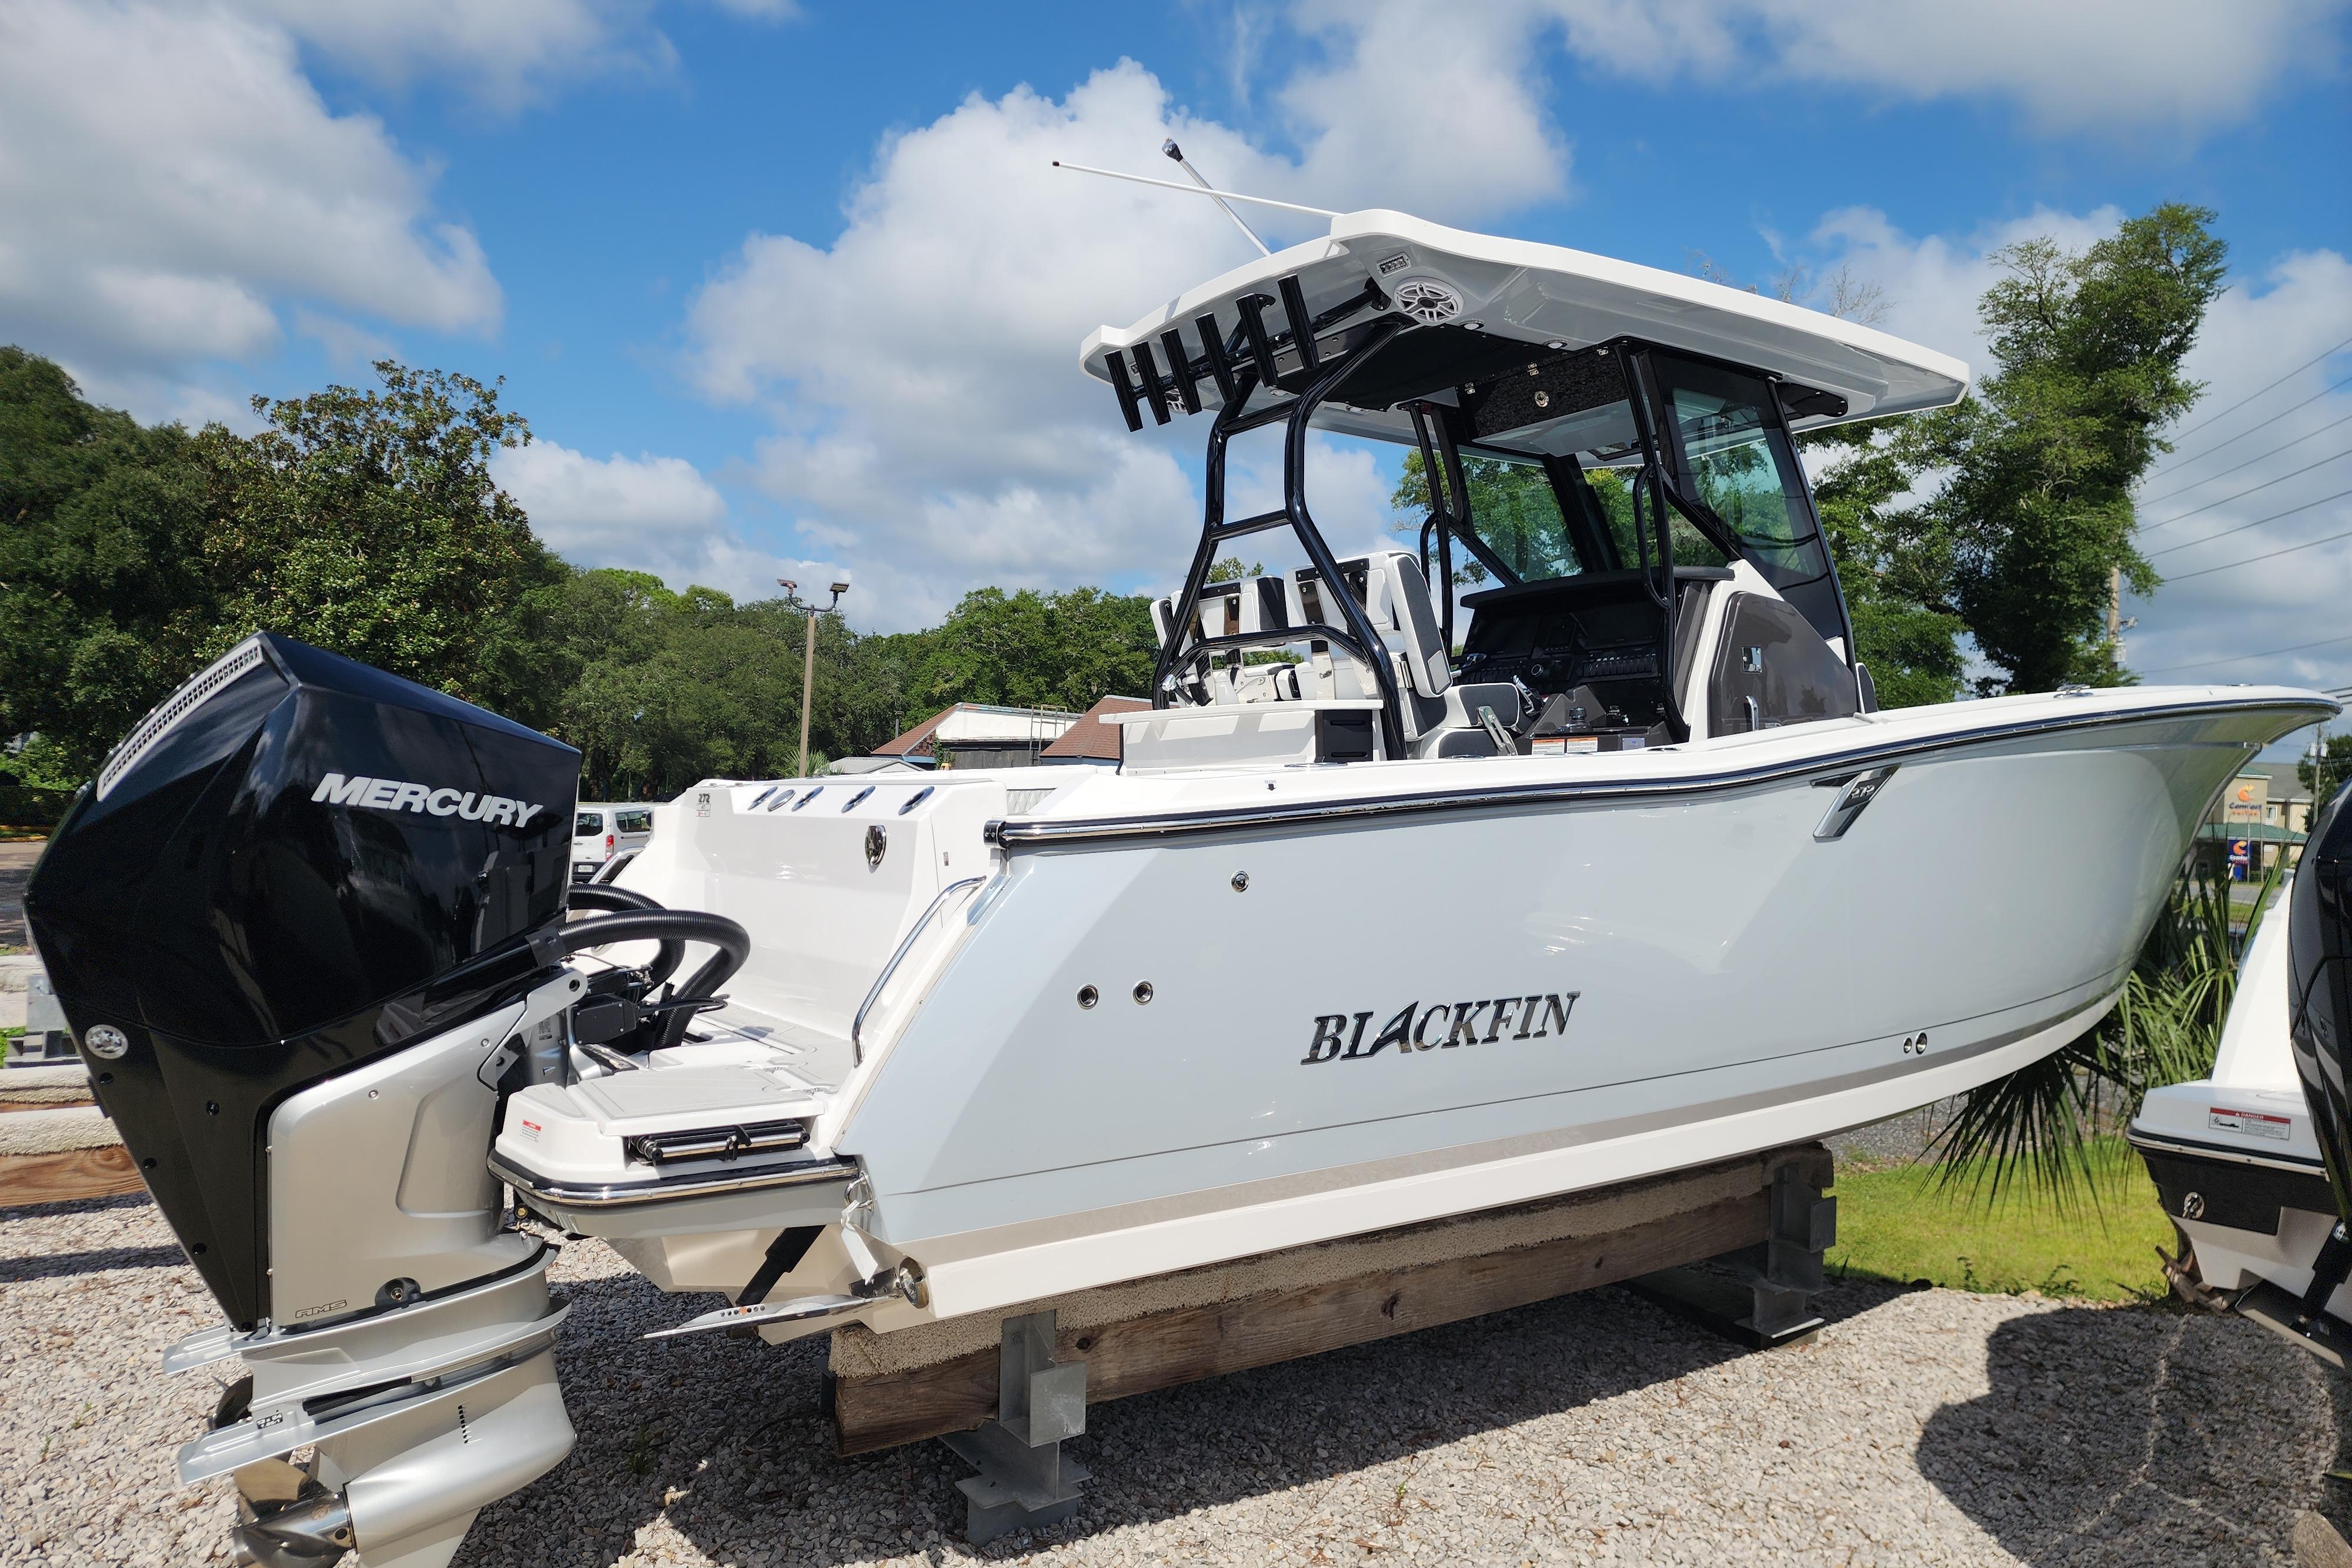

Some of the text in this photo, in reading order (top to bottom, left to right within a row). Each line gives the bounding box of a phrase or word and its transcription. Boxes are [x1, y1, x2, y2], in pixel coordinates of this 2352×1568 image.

[310, 773, 543, 828] MERCURY
[1850, 784, 1875, 800] 272
[1300, 991, 1581, 1065] BLACKFIN
[295, 1299, 347, 1318] AMS
